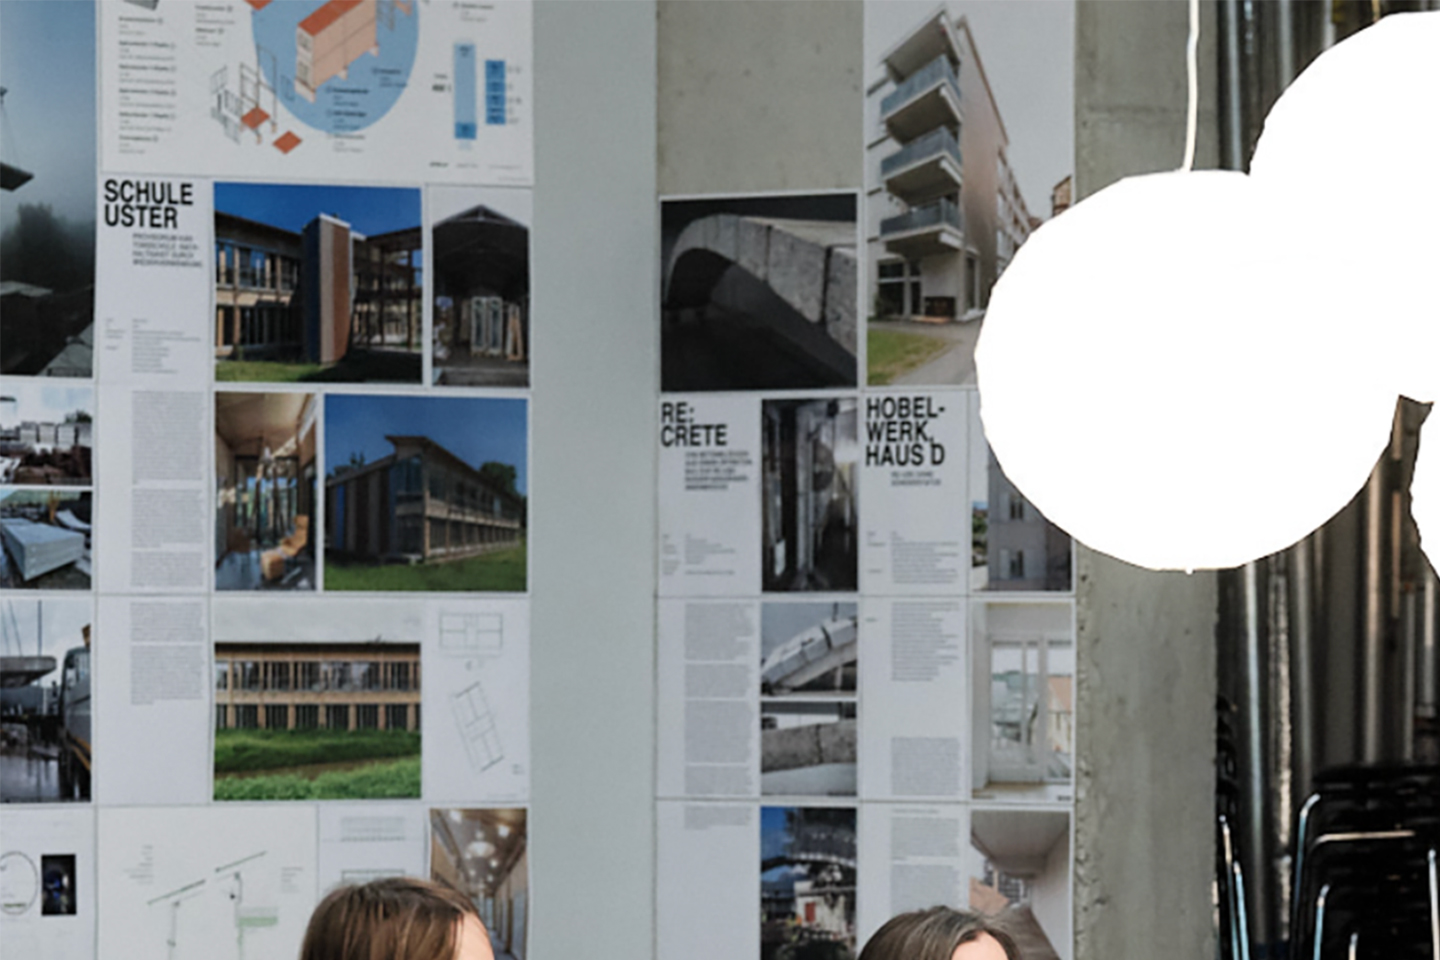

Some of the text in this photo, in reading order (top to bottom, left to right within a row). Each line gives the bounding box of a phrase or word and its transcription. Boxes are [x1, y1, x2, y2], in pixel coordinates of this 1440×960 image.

[104, 179, 194, 206] SCHULE
[104, 204, 178, 229] USTER
[661, 402, 694, 424] RE:
[866, 397, 945, 419] HOBEL-
[661, 424, 727, 448] CRETE
[866, 420, 935, 444] WERK,
[866, 443, 945, 467] HAUS D
